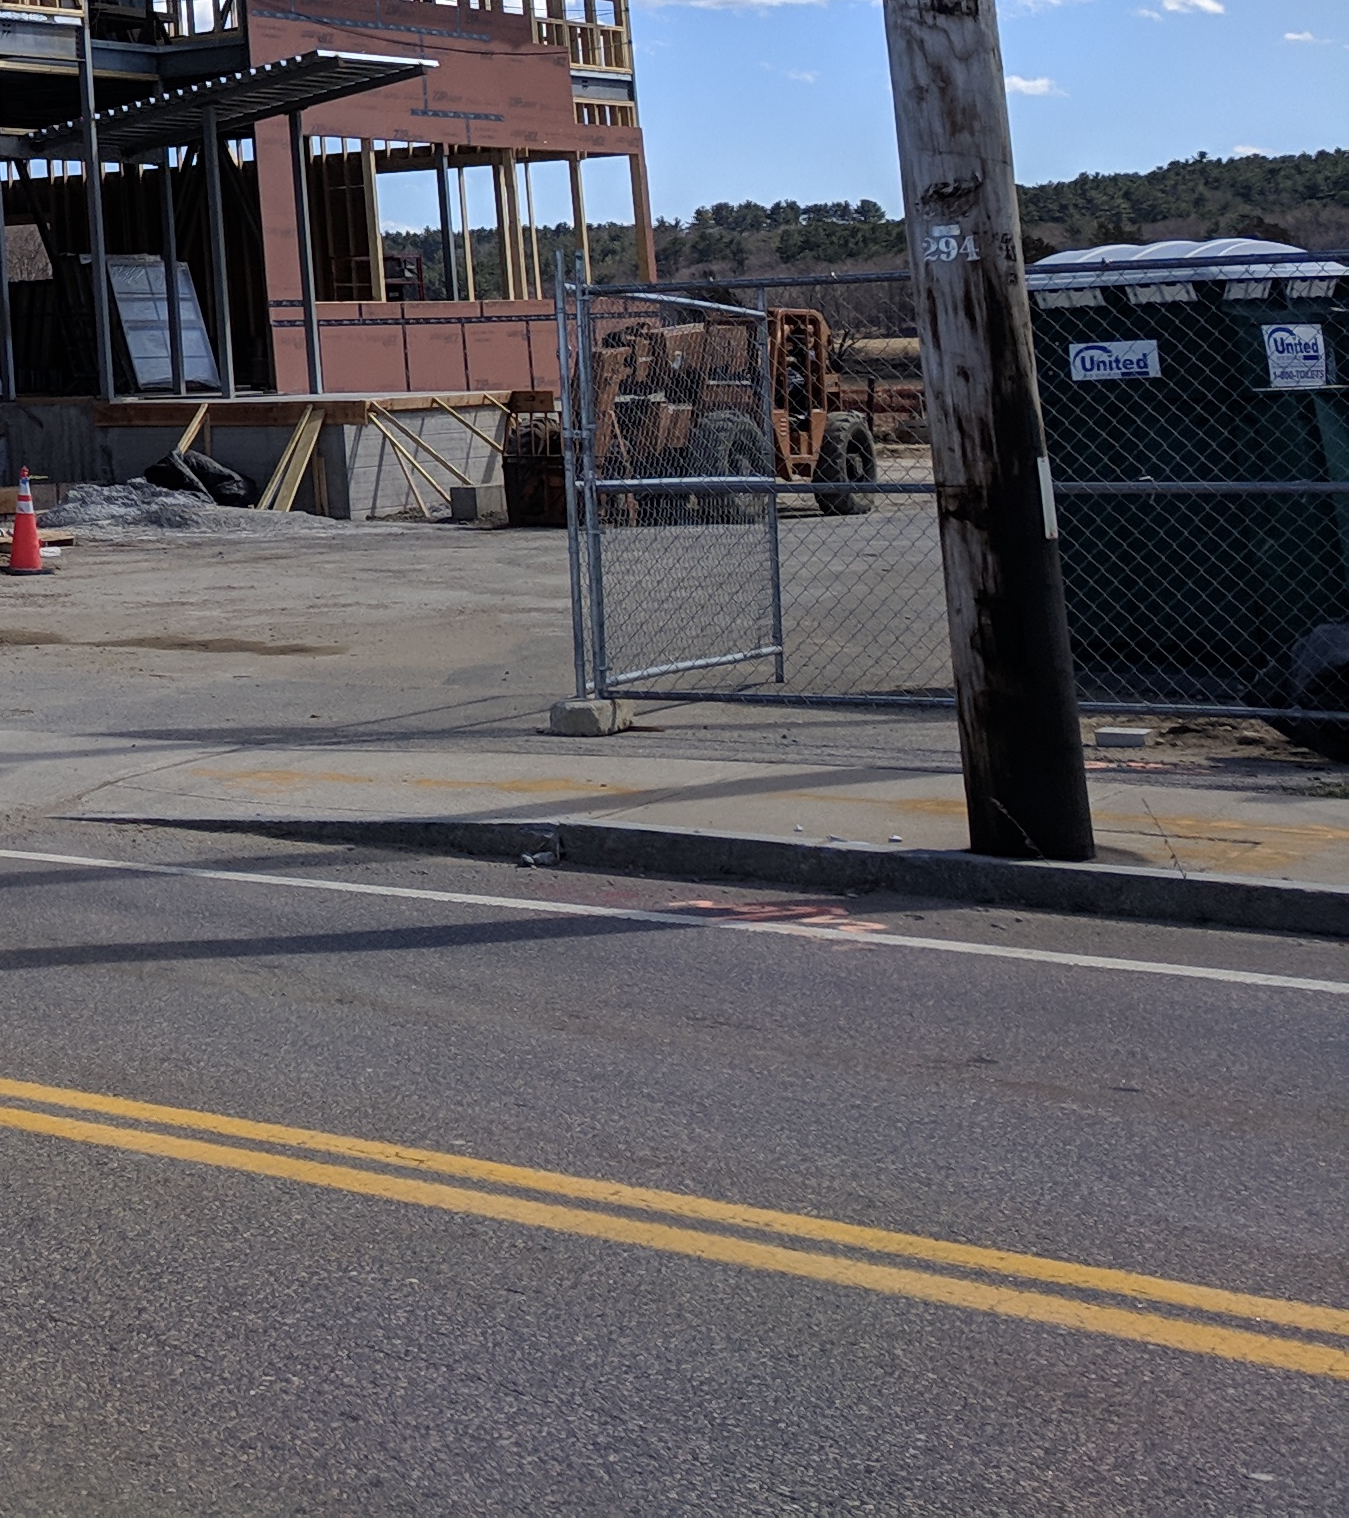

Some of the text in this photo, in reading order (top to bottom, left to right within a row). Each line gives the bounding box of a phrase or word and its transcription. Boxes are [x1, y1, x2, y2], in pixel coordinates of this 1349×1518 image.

[922, 235, 980, 261] 294
[1273, 336, 1320, 355] United
[1081, 353, 1149, 372] United
